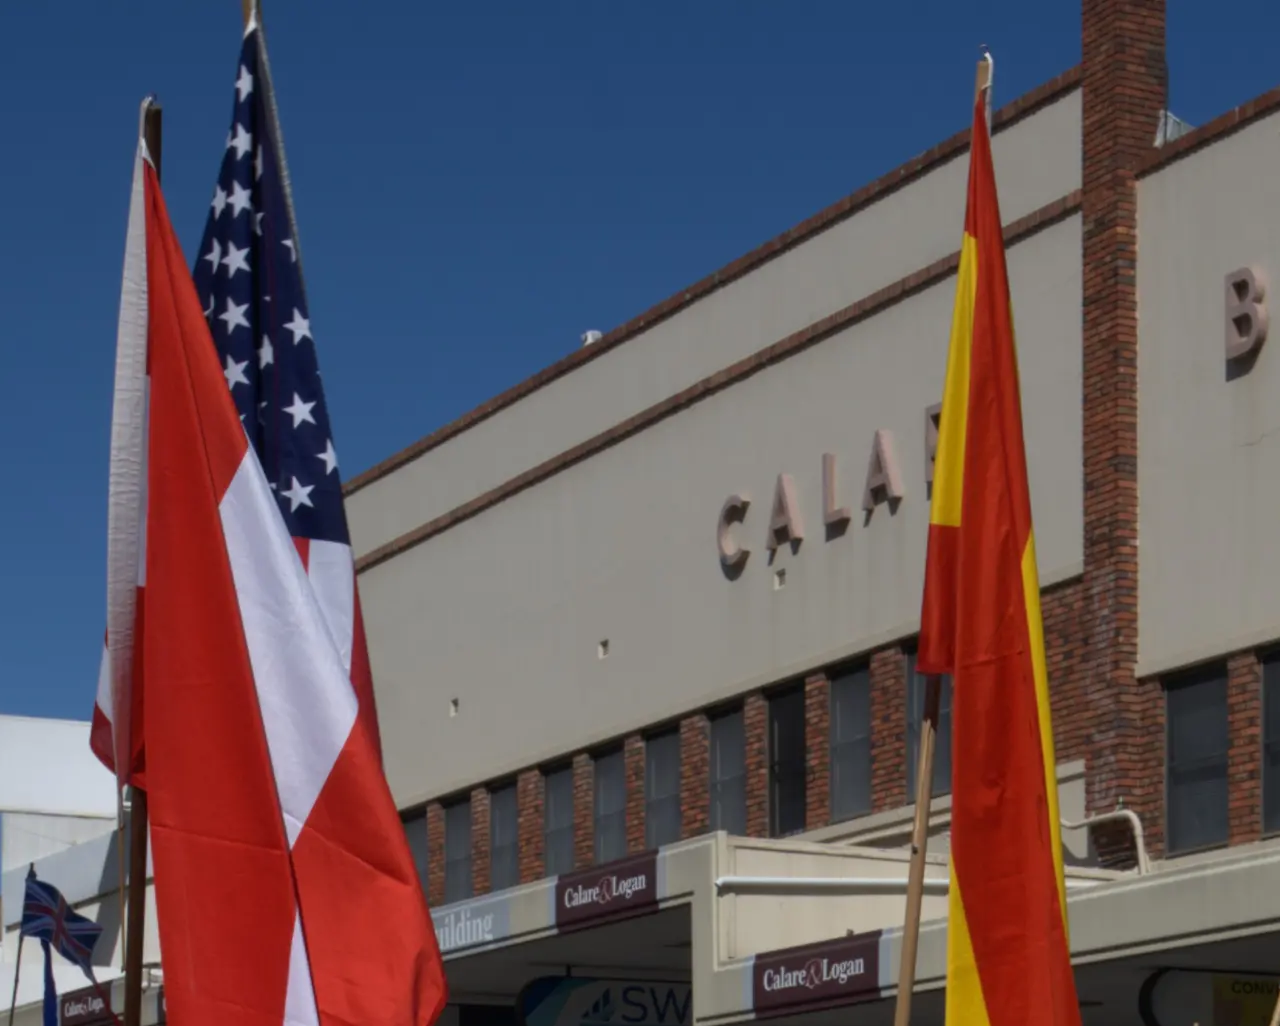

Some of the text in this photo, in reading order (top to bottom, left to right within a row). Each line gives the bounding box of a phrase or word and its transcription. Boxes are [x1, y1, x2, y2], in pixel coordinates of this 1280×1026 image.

[564, 884, 600, 908] Calare
[612, 874, 646, 899] Logan
[436, 908, 494, 951] uilding
[763, 965, 807, 991] Calare
[822, 957, 865, 984] Logan
